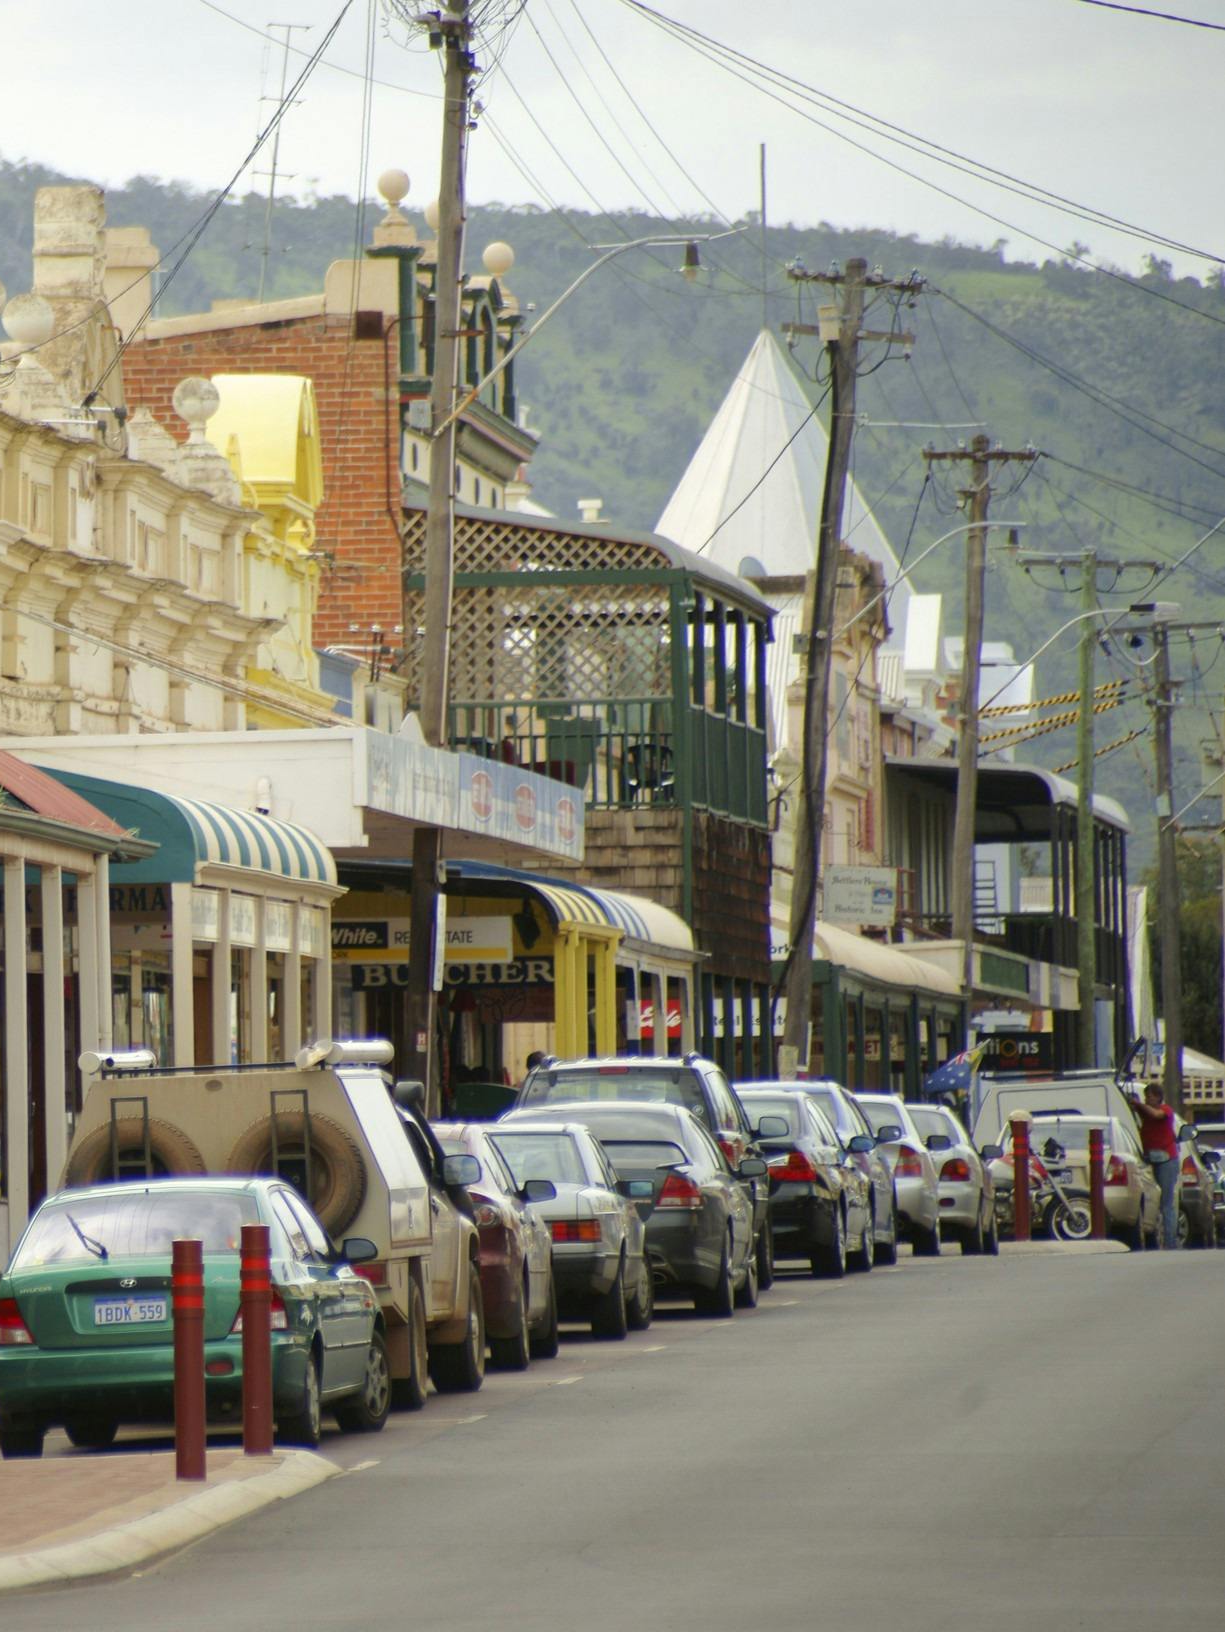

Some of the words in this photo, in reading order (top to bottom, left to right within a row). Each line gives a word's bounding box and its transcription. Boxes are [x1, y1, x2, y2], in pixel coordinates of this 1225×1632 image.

[394, 930, 410, 945] RE
[447, 930, 473, 944] TATE
[362, 961, 554, 987] BUCHER
